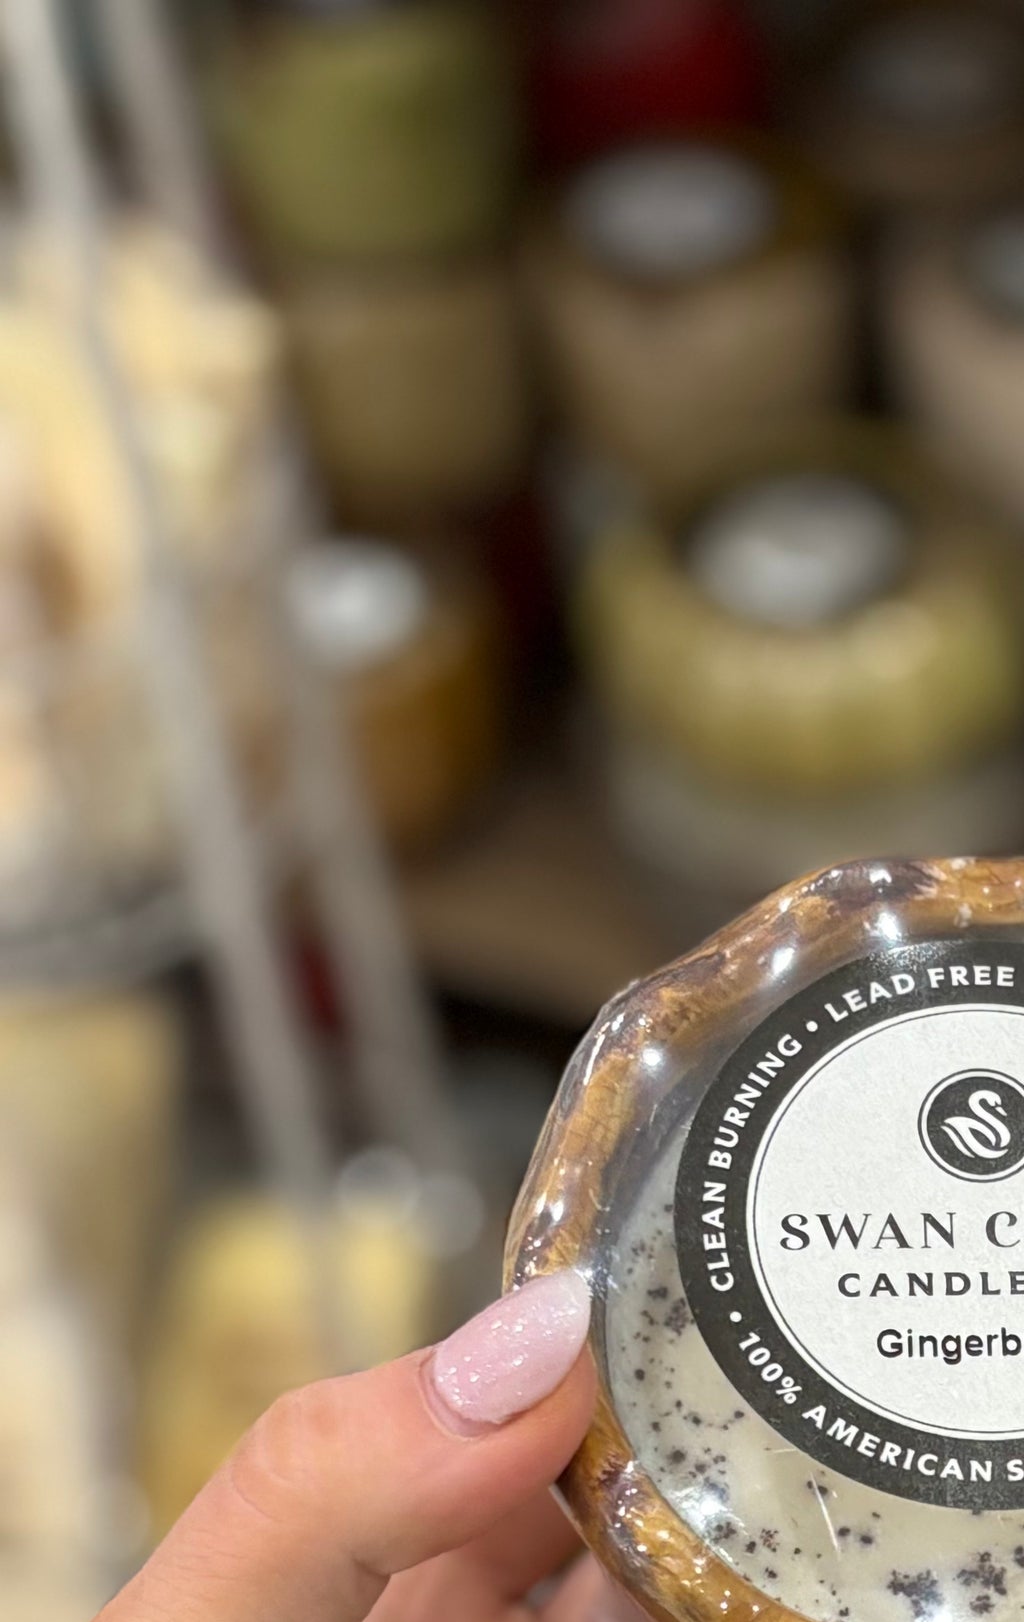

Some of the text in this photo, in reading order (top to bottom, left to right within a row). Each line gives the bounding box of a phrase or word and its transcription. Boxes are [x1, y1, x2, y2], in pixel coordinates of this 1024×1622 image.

[825, 965, 1016, 1023] LEAD FREE
[702, 1034, 803, 1292] CLEAN BURNING
[779, 1212, 956, 1250] SWAN
[739, 1331, 803, 1405] 100%
[802, 1404, 993, 1483] AMERICAN
